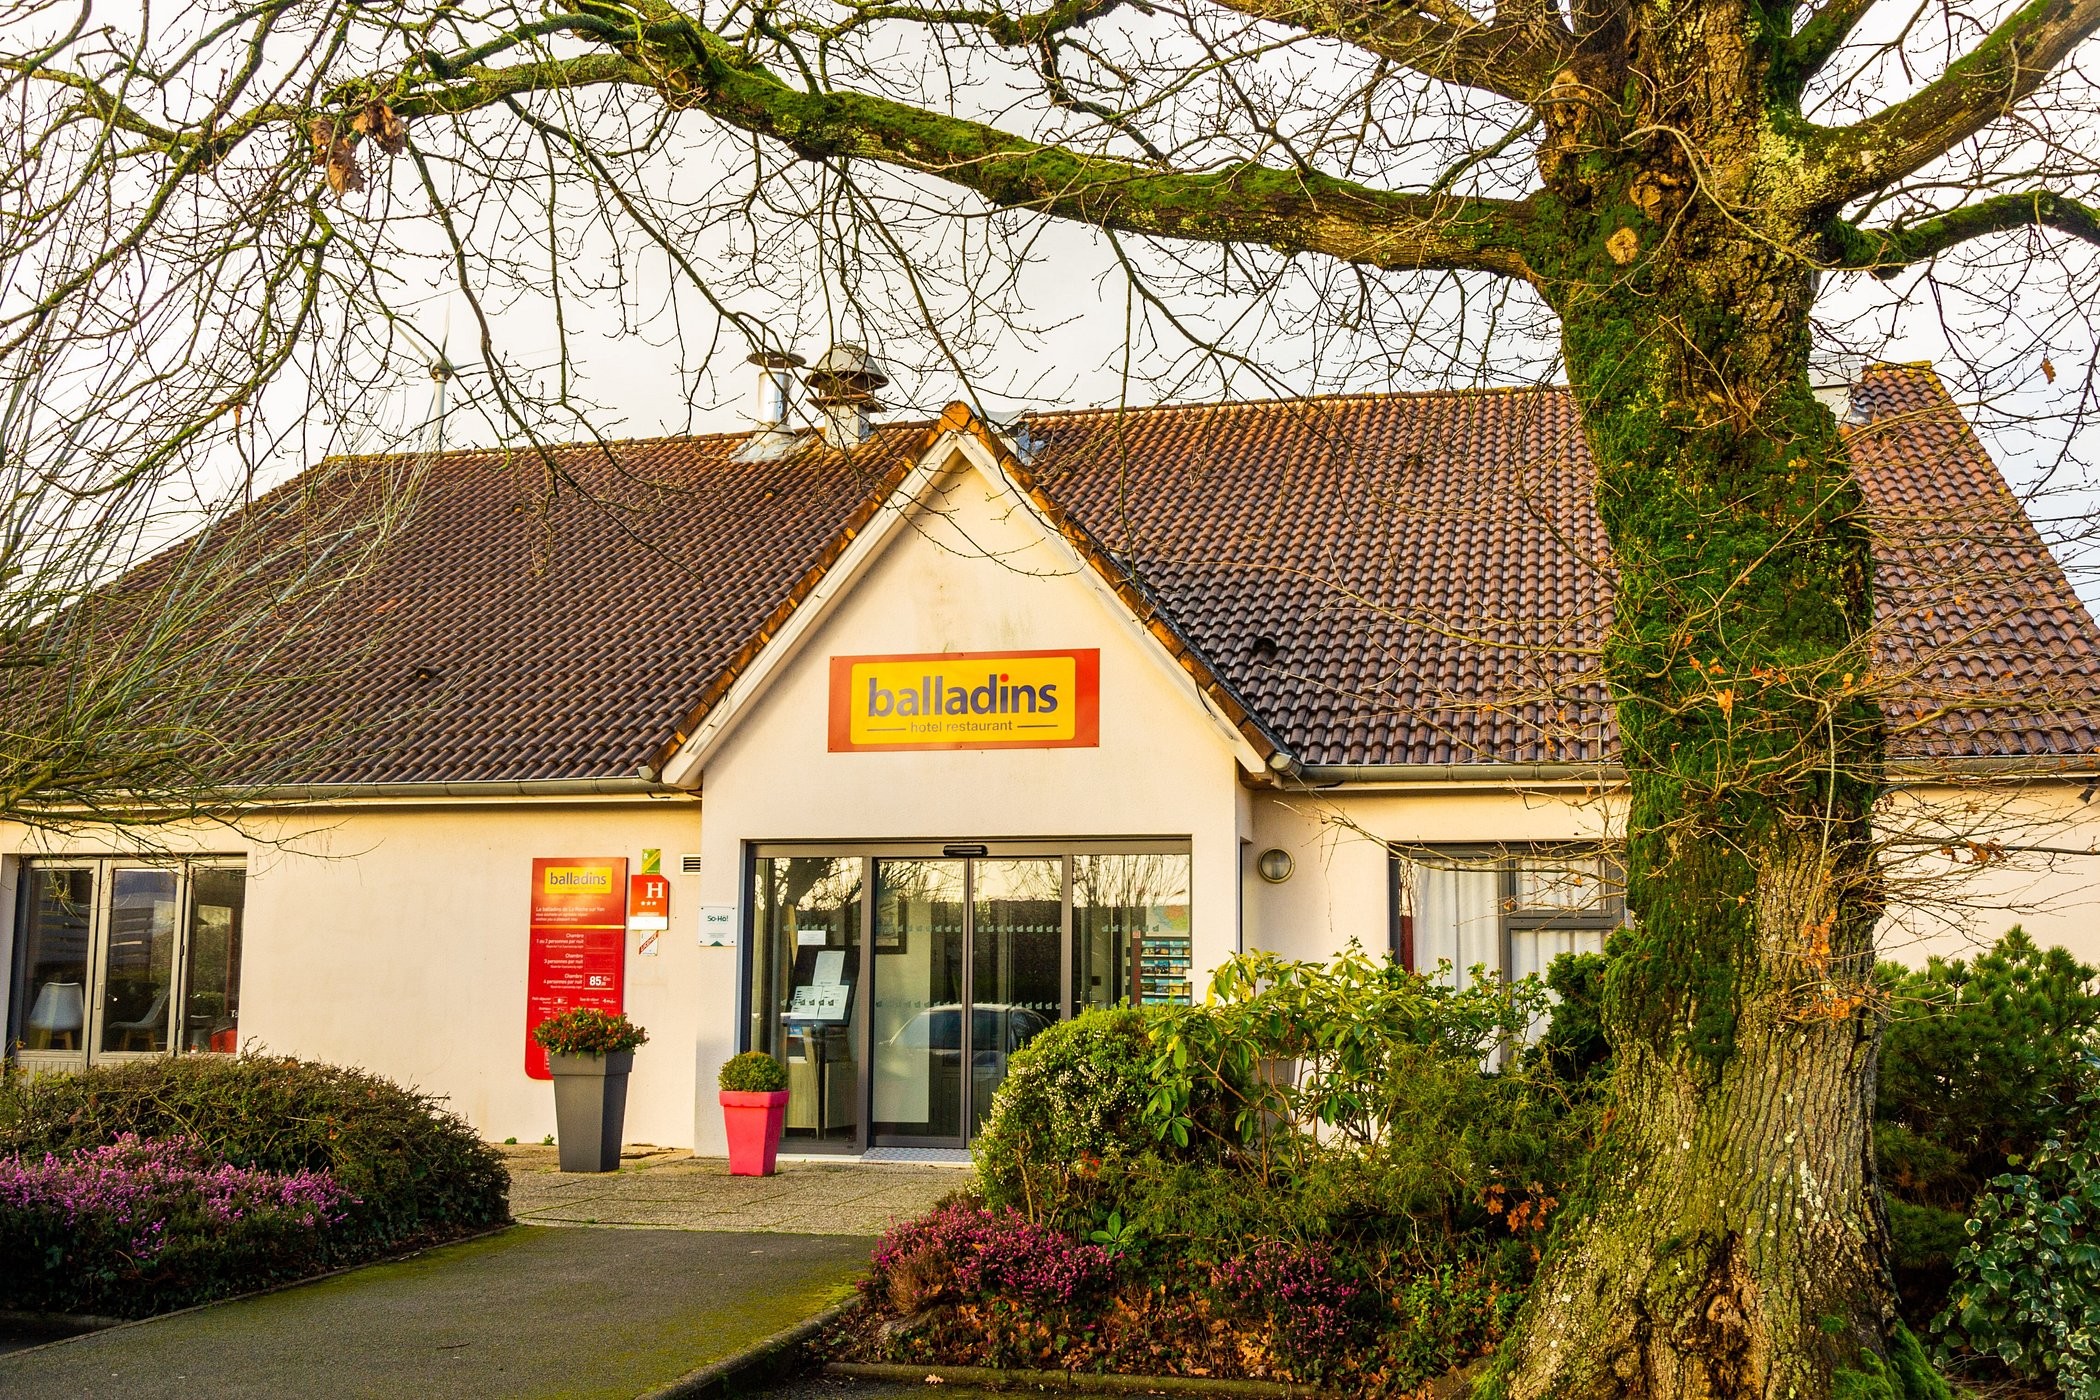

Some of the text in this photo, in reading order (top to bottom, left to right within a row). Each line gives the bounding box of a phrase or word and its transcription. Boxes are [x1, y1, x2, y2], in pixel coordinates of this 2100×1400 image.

[868, 673, 1058, 717] balladins
[910, 720, 1013, 733] hotel restaurant
[550, 872, 607, 885] balladins
[646, 882, 664, 898] H
[589, 976, 602, 986] 85
